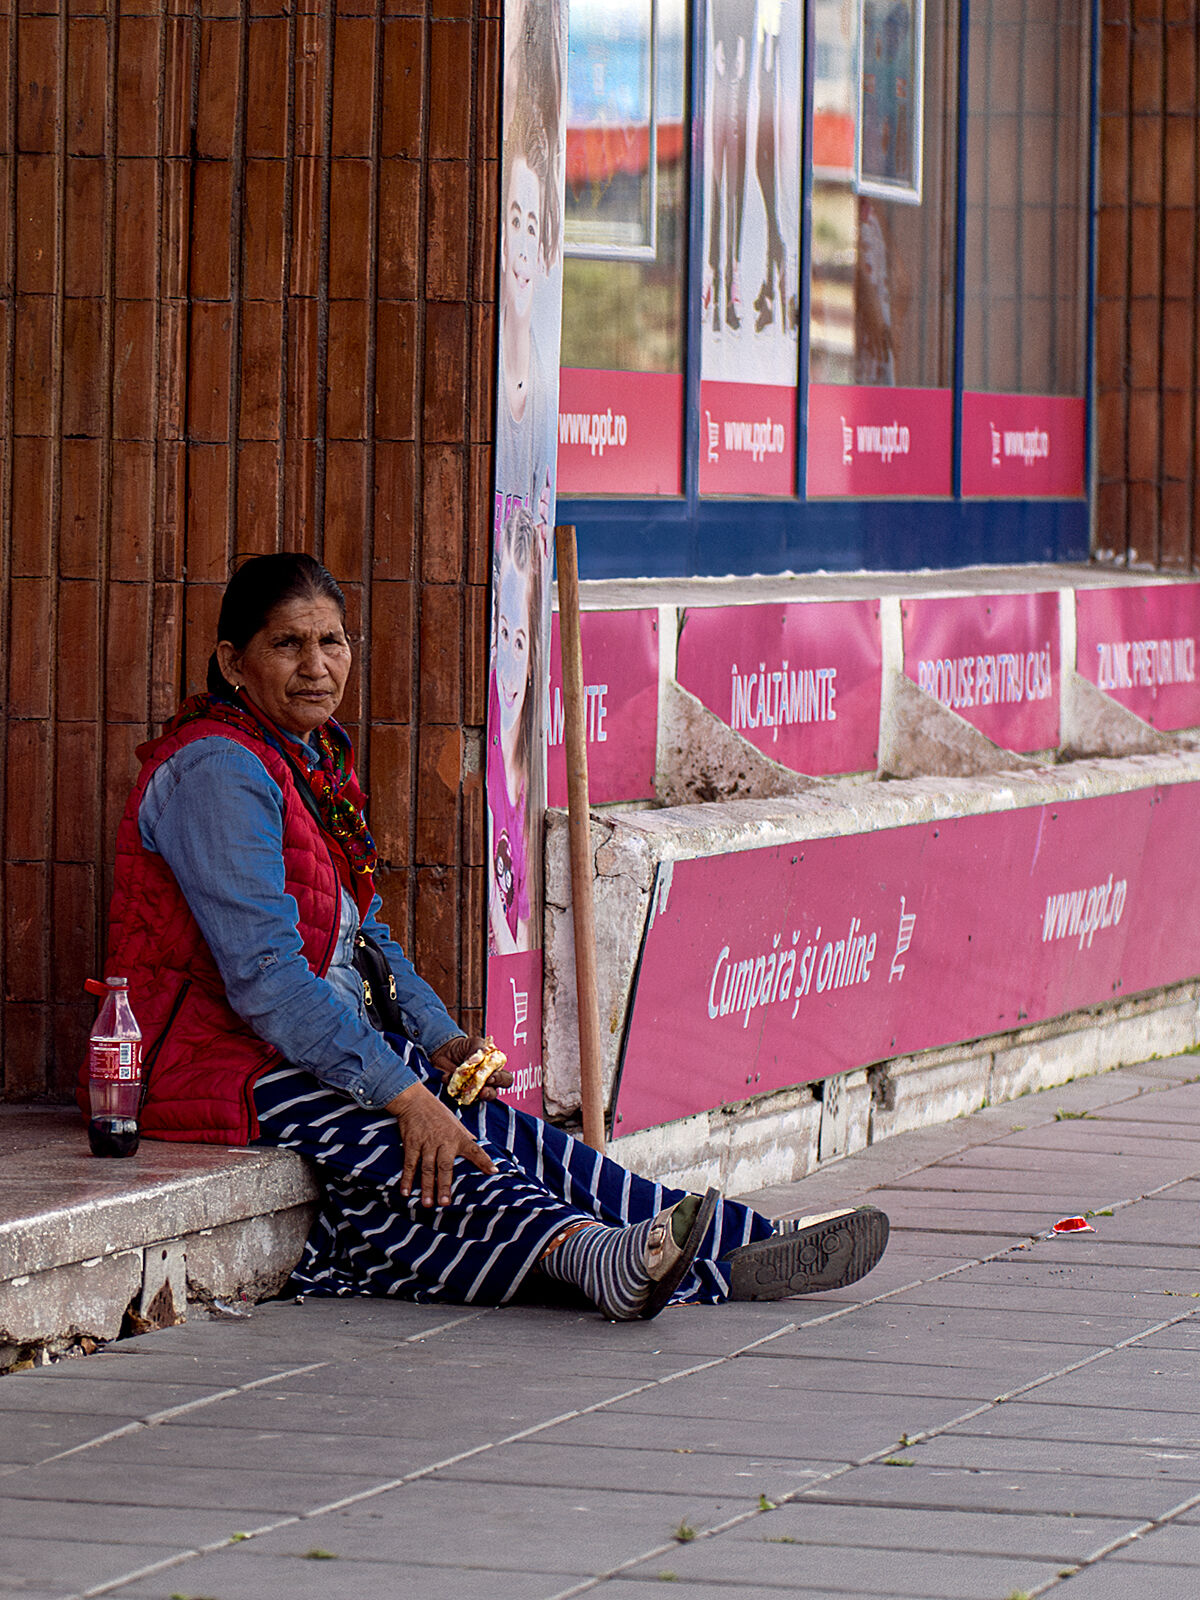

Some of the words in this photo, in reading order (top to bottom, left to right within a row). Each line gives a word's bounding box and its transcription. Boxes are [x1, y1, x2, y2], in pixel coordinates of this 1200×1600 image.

[558, 408, 627, 456] www.ppt.ro
[724, 416, 784, 462] www.ppt.ro
[856, 420, 910, 463] www.ppt.ro
[974, 652, 1025, 706] PENTRU
[1042, 872, 1127, 951] www.ppt.ro
[707, 929, 801, 1029] Cumpără
[816, 916, 877, 994] online
